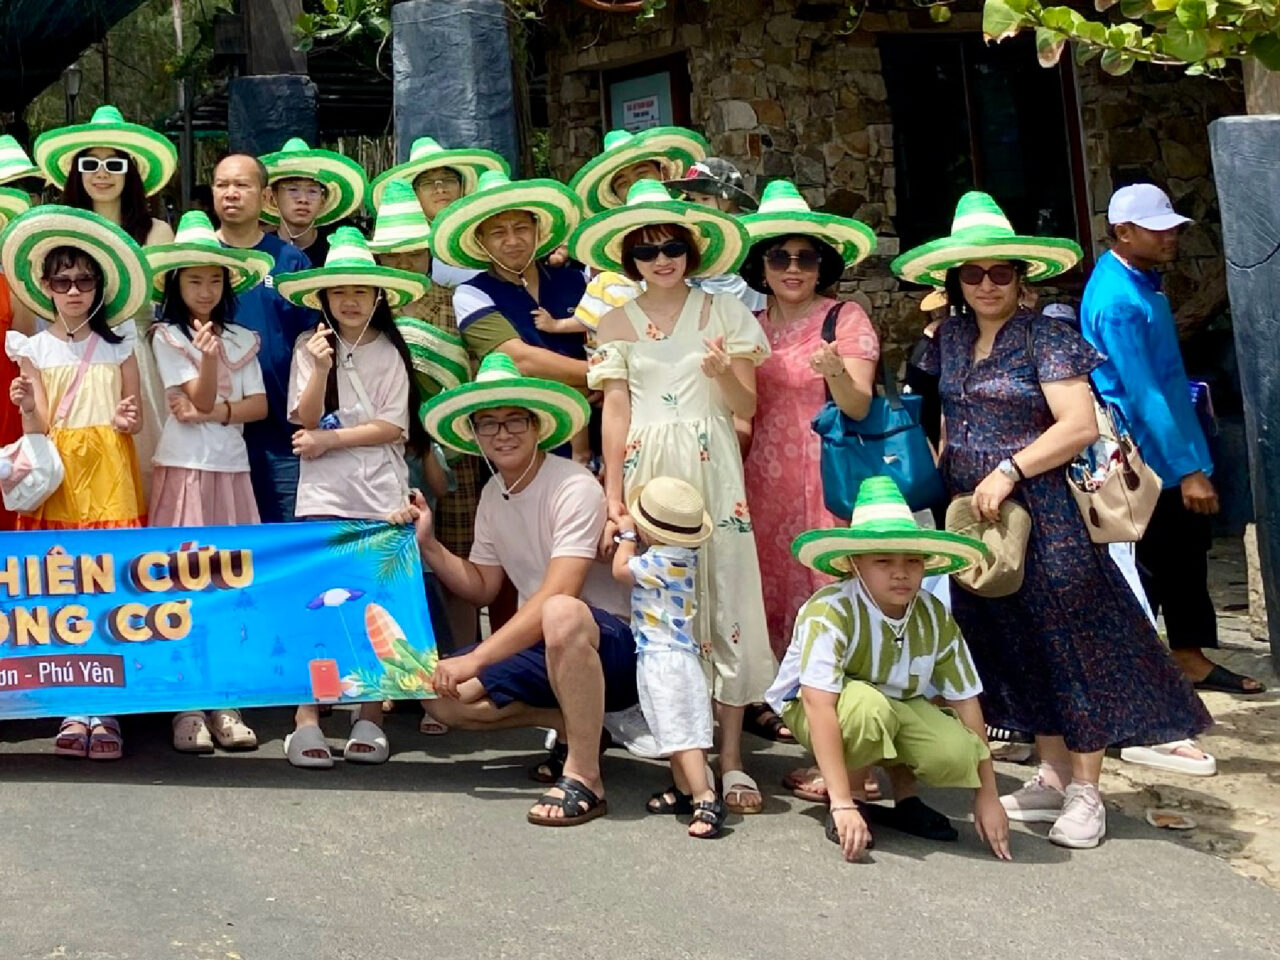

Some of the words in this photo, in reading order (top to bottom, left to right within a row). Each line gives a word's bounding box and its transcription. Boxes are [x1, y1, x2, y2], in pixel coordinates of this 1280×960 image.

[129, 541, 254, 592] CỨU
[107, 598, 193, 642] CƠ
[39, 660, 73, 684] Phú
[79, 660, 114, 684] Yên
